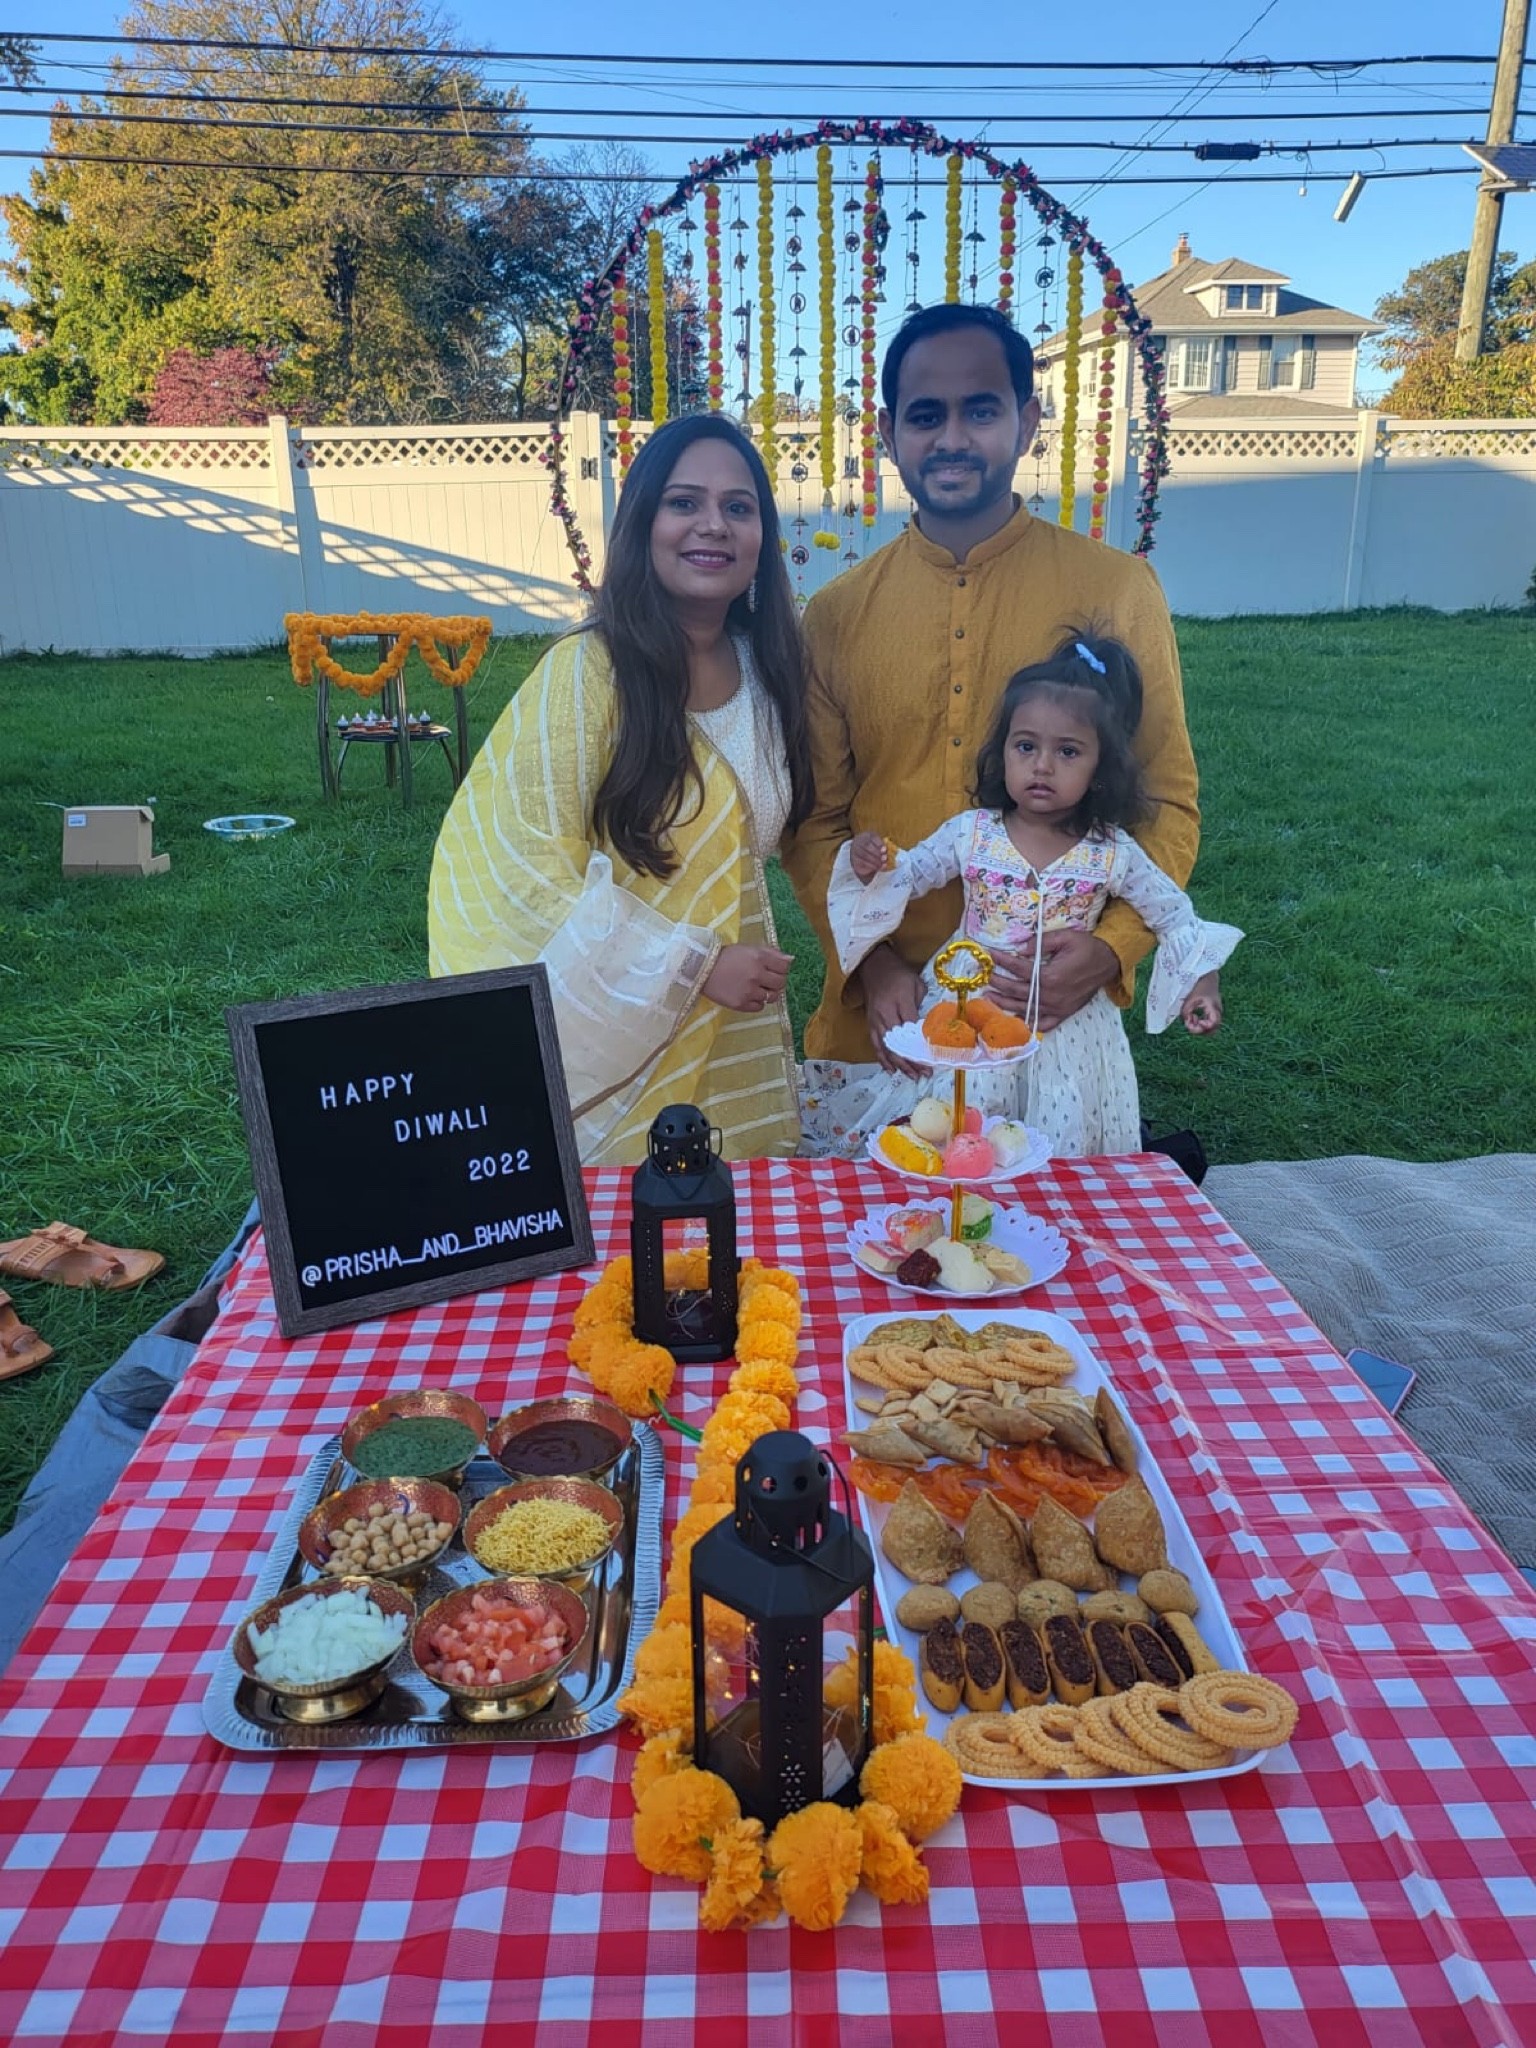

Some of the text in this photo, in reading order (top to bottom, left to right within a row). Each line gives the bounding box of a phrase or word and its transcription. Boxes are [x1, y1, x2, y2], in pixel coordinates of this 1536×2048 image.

[320, 1072, 414, 1110] HAPPY
[394, 1105, 488, 1143] DIWALI
[468, 1149, 531, 1181] 2022
[301, 1208, 564, 1287] @PRISHA_AND_BHAVISHA
